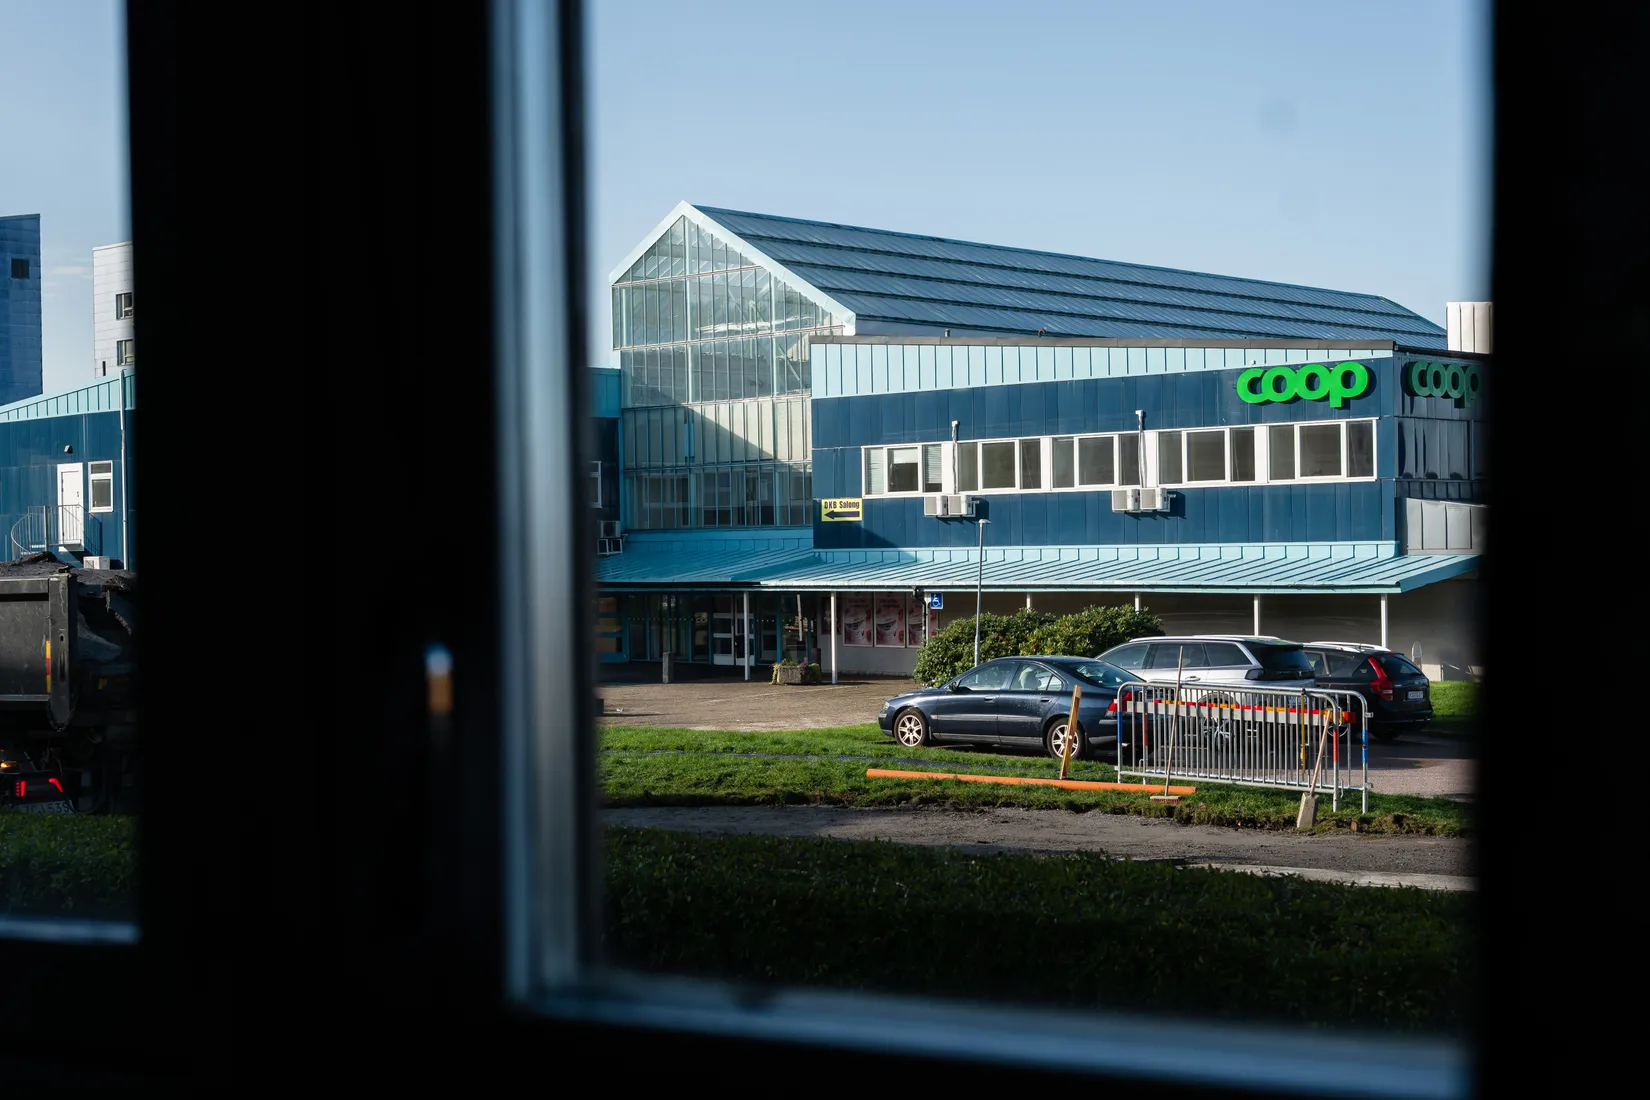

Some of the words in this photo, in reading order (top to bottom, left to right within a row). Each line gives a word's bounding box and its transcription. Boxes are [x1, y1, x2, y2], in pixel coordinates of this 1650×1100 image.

[1236, 362, 1369, 408] coop
[1410, 361, 1484, 408] coop
[839, 501, 859, 509] Salong
